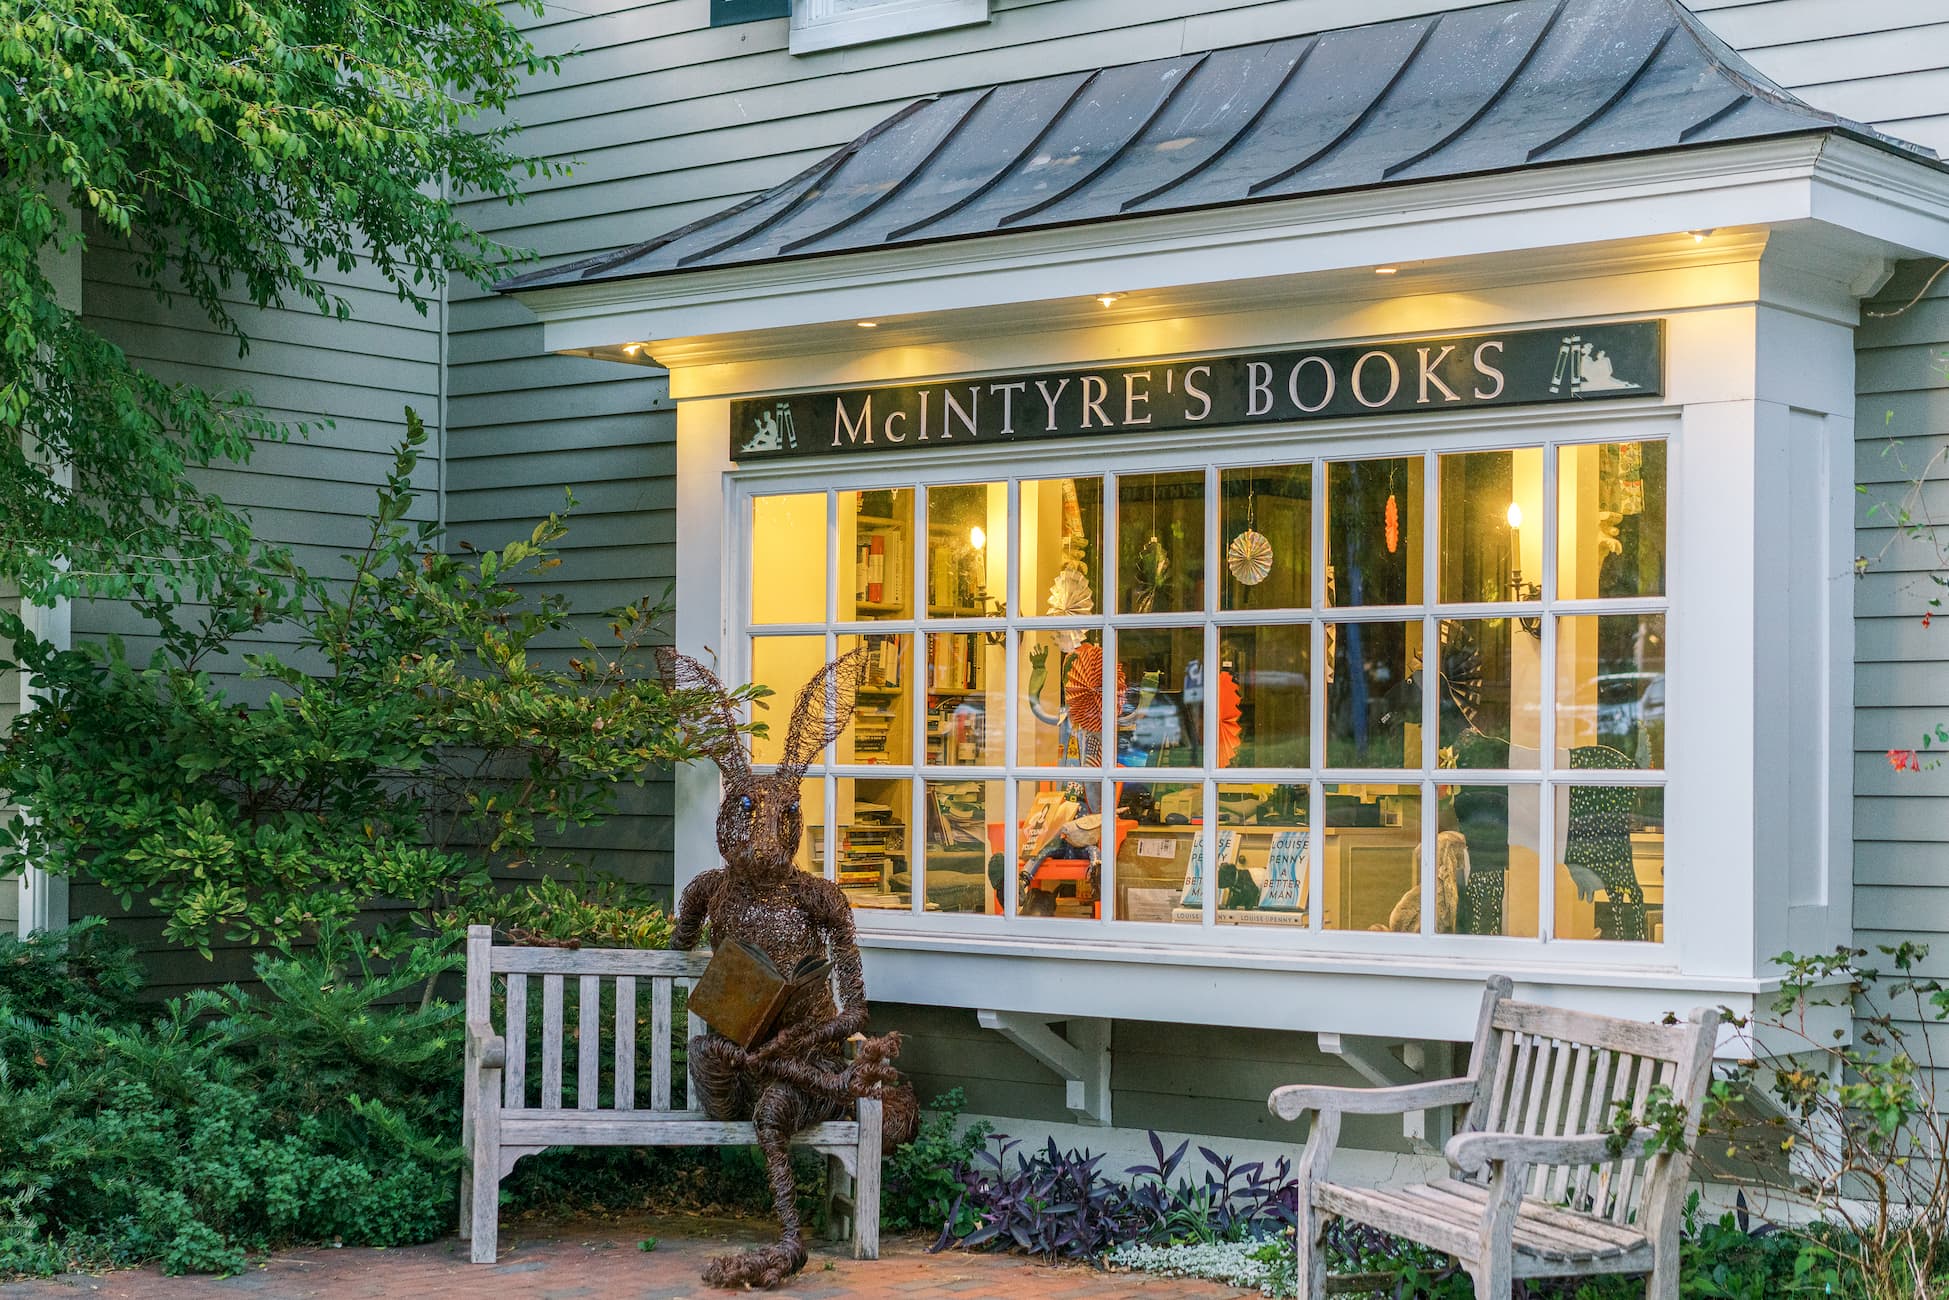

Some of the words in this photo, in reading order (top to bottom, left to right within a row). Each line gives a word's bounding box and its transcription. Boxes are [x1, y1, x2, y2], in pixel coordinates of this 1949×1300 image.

[831, 366, 1212, 447] McINTYRE'S
[1246, 341, 1505, 417] BOOKS
[1193, 839, 1231, 848] LOSE
[1272, 840, 1309, 850] LOUISE
[1191, 853, 1228, 862] PEY
[1270, 854, 1306, 864] PENNY
[1281, 868, 1287, 877] A
[1263, 879, 1301, 889] BETTER
[1269, 890, 1293, 900] MAN
[1176, 912, 1200, 920] LOUISE
[1240, 914, 1264, 922] LOUISE
